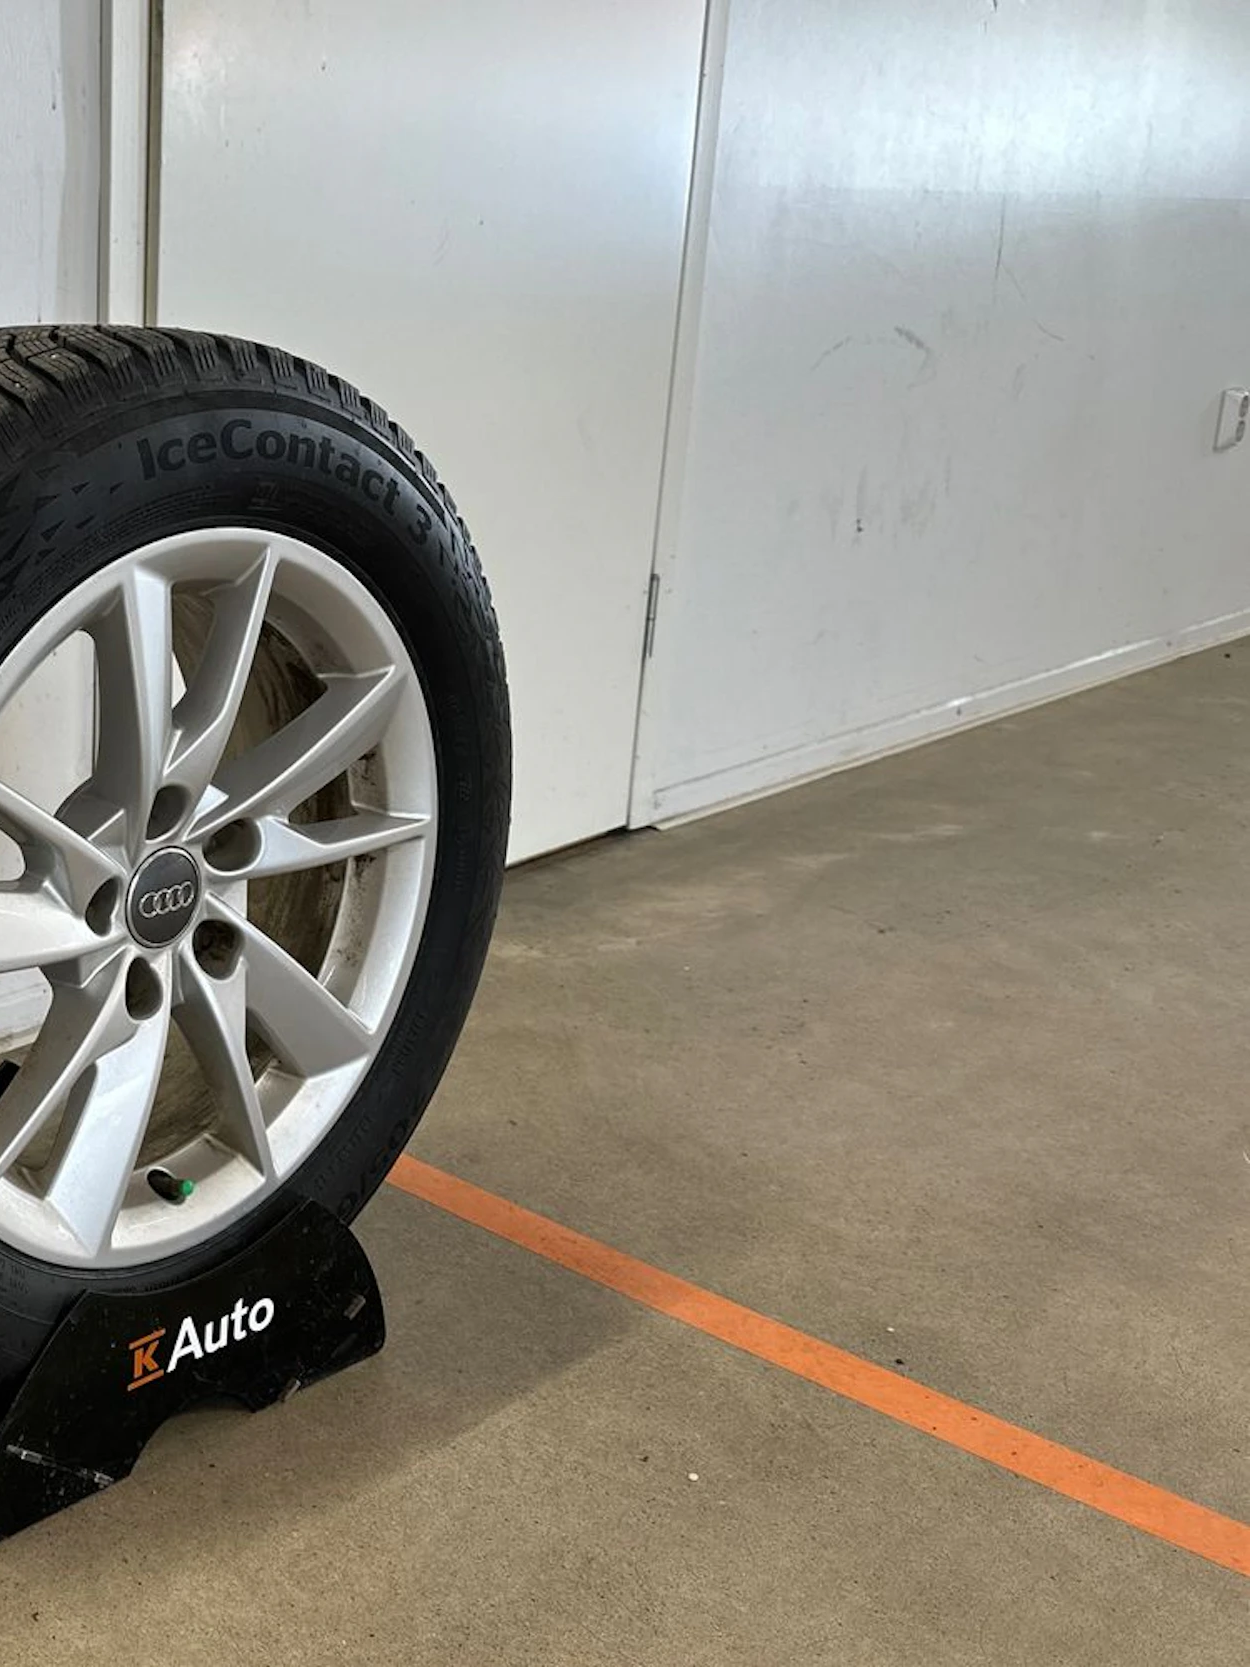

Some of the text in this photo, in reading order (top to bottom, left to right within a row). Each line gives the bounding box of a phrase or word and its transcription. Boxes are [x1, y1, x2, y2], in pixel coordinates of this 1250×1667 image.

[137, 419, 432, 546] IceContact 3
[166, 1298, 274, 1373] Auto
